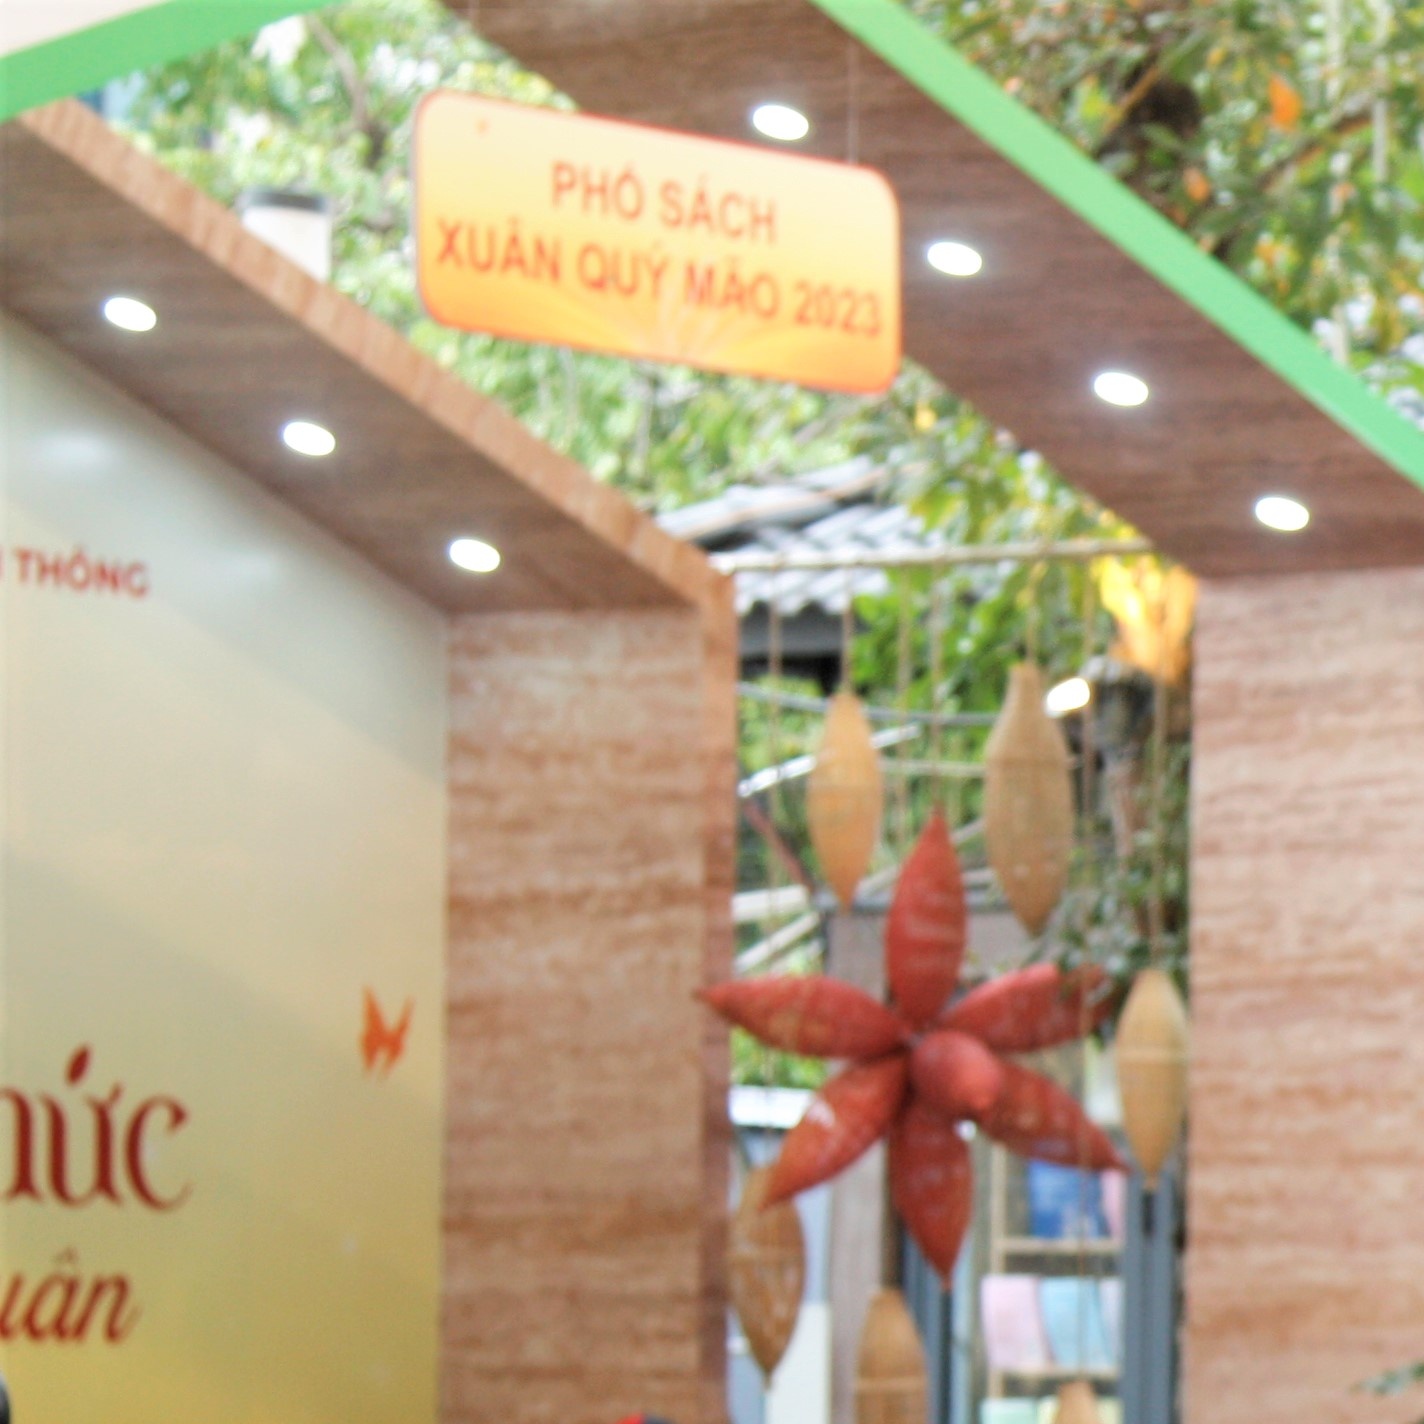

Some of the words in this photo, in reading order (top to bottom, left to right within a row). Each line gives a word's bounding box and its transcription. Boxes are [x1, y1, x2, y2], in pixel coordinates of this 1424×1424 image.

[658, 170, 778, 245] SÁCH
[436, 216, 562, 286] XUÂN
[794, 278, 881, 338] 2023
